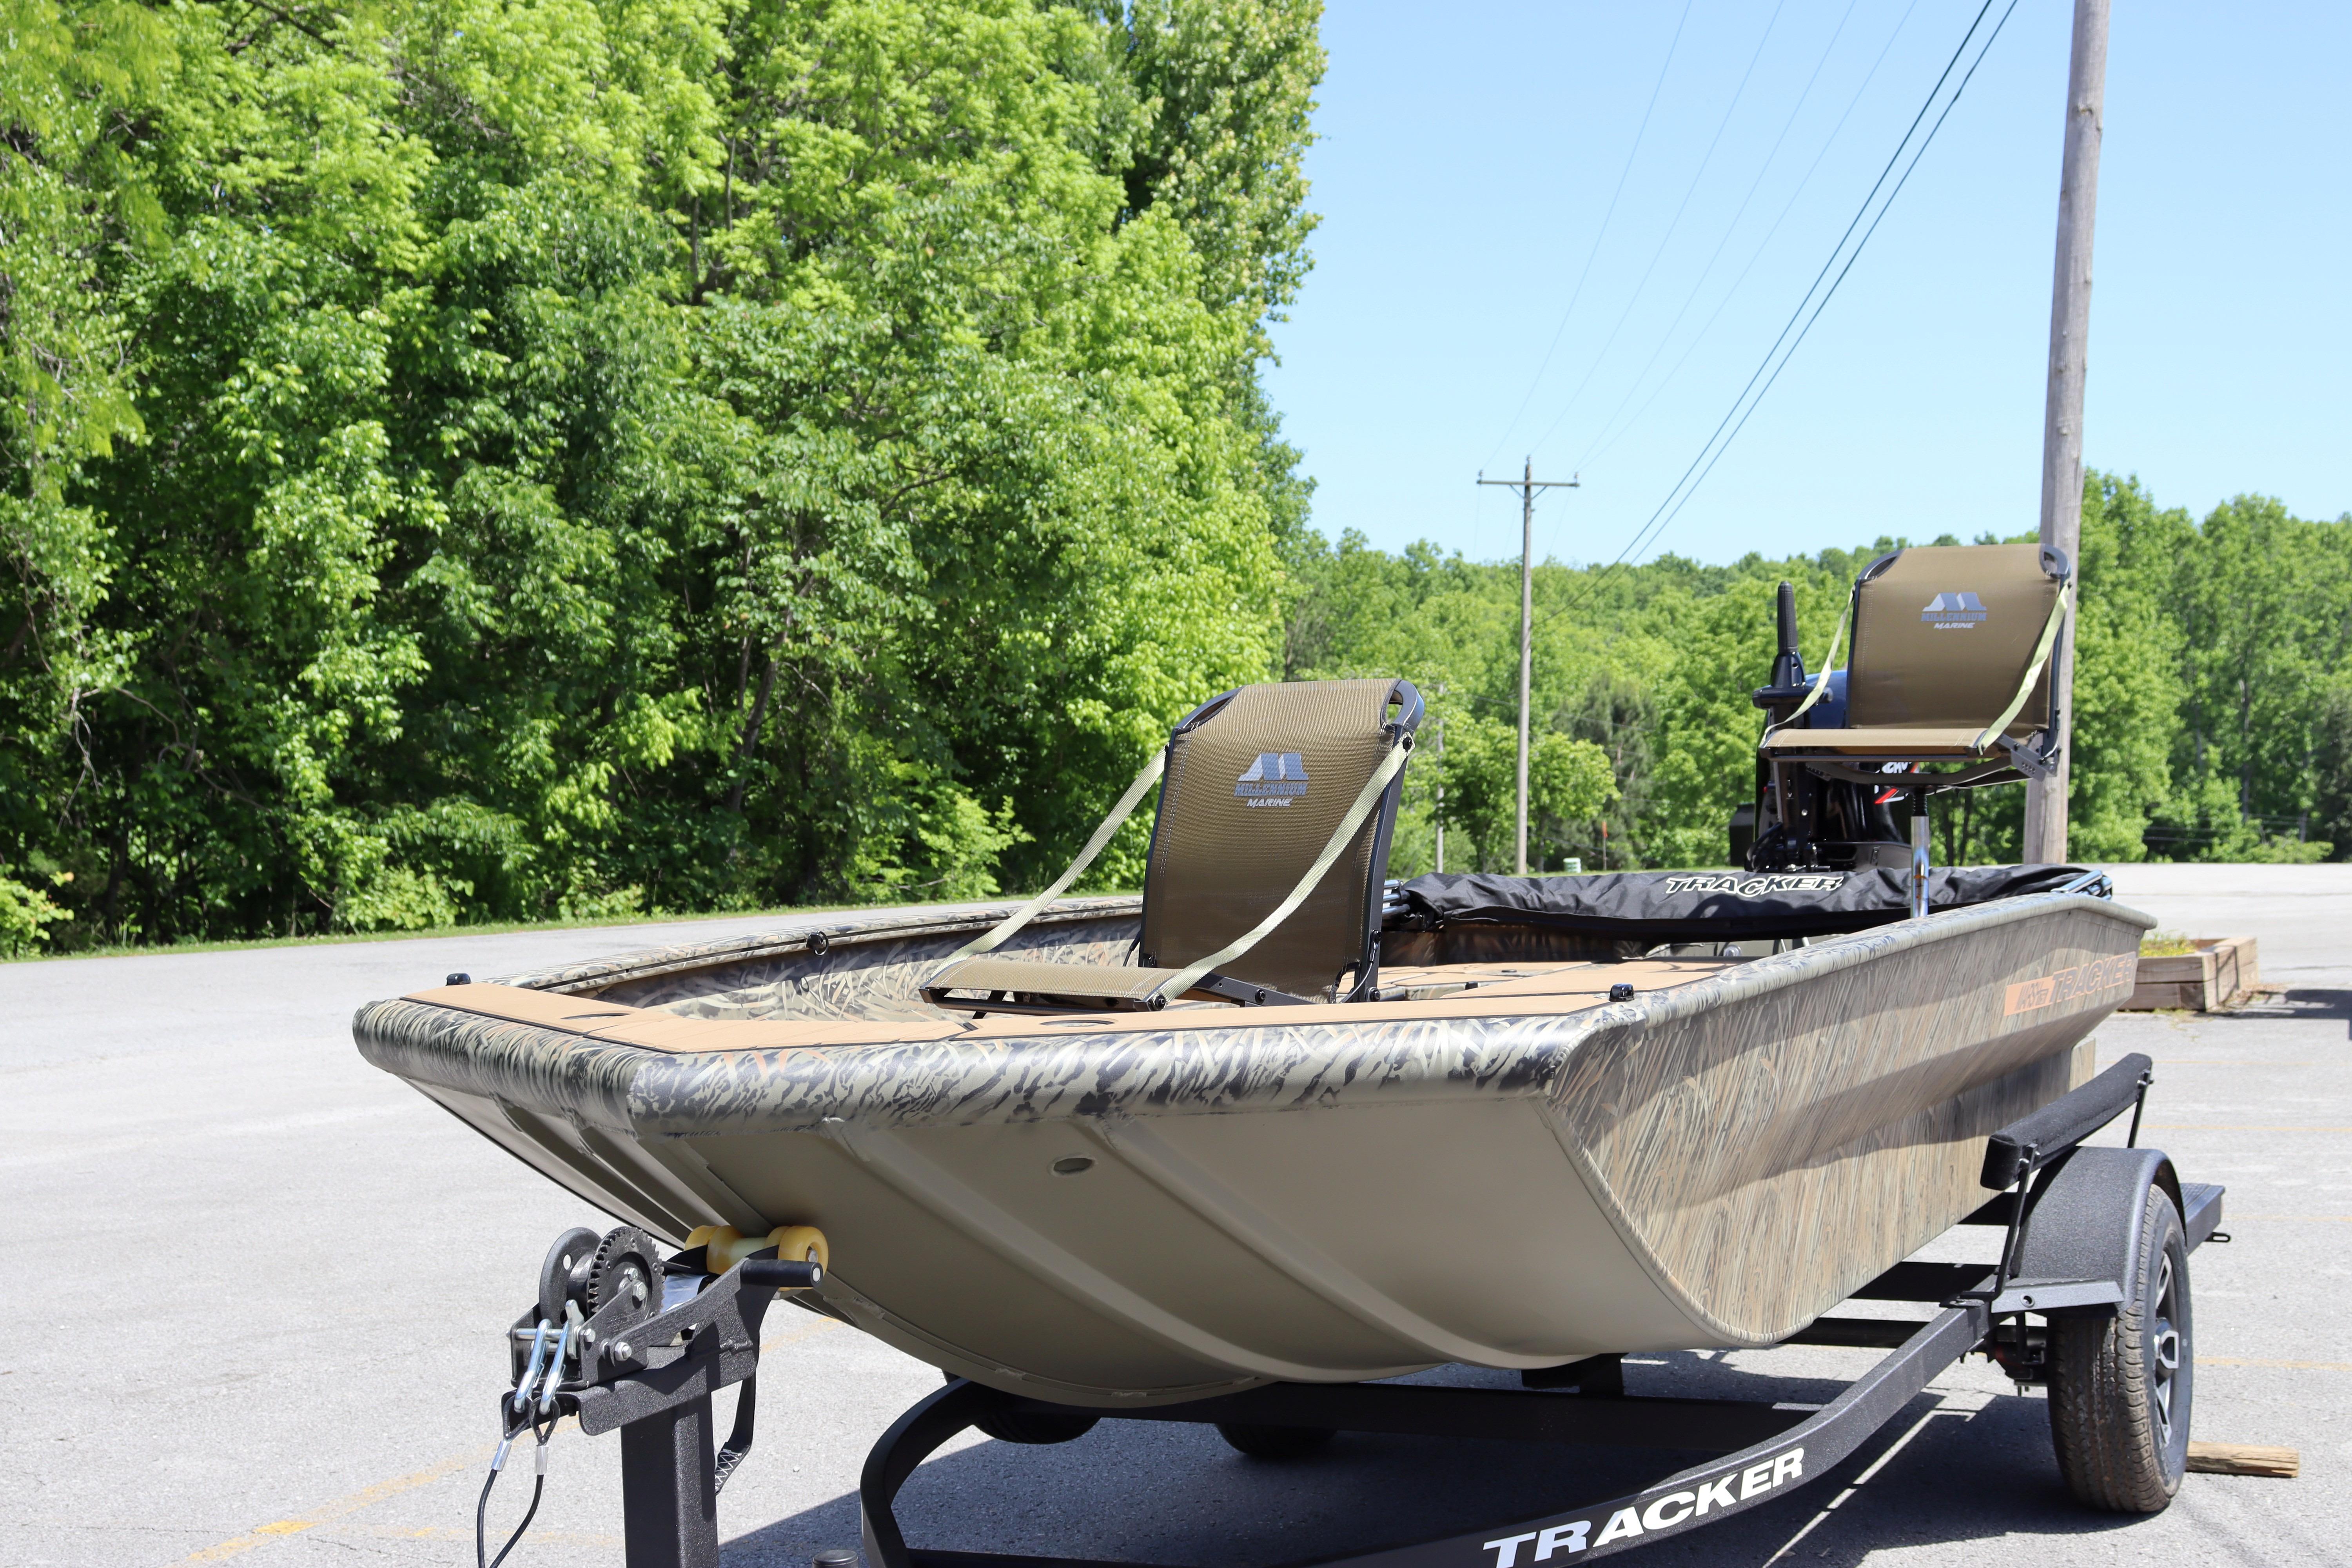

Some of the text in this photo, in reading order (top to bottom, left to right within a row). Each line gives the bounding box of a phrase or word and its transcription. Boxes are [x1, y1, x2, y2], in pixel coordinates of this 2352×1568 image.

[1921, 613, 1987, 621] MILLENNIUM
[1234, 783, 1308, 797] MILLENNIUM
[1246, 798, 1293, 808] MARINE
[1666, 875, 1844, 897] TRACKER
[2049, 951, 2136, 1004] TRACKER
[1483, 1447, 1804, 1568] TRACKER
